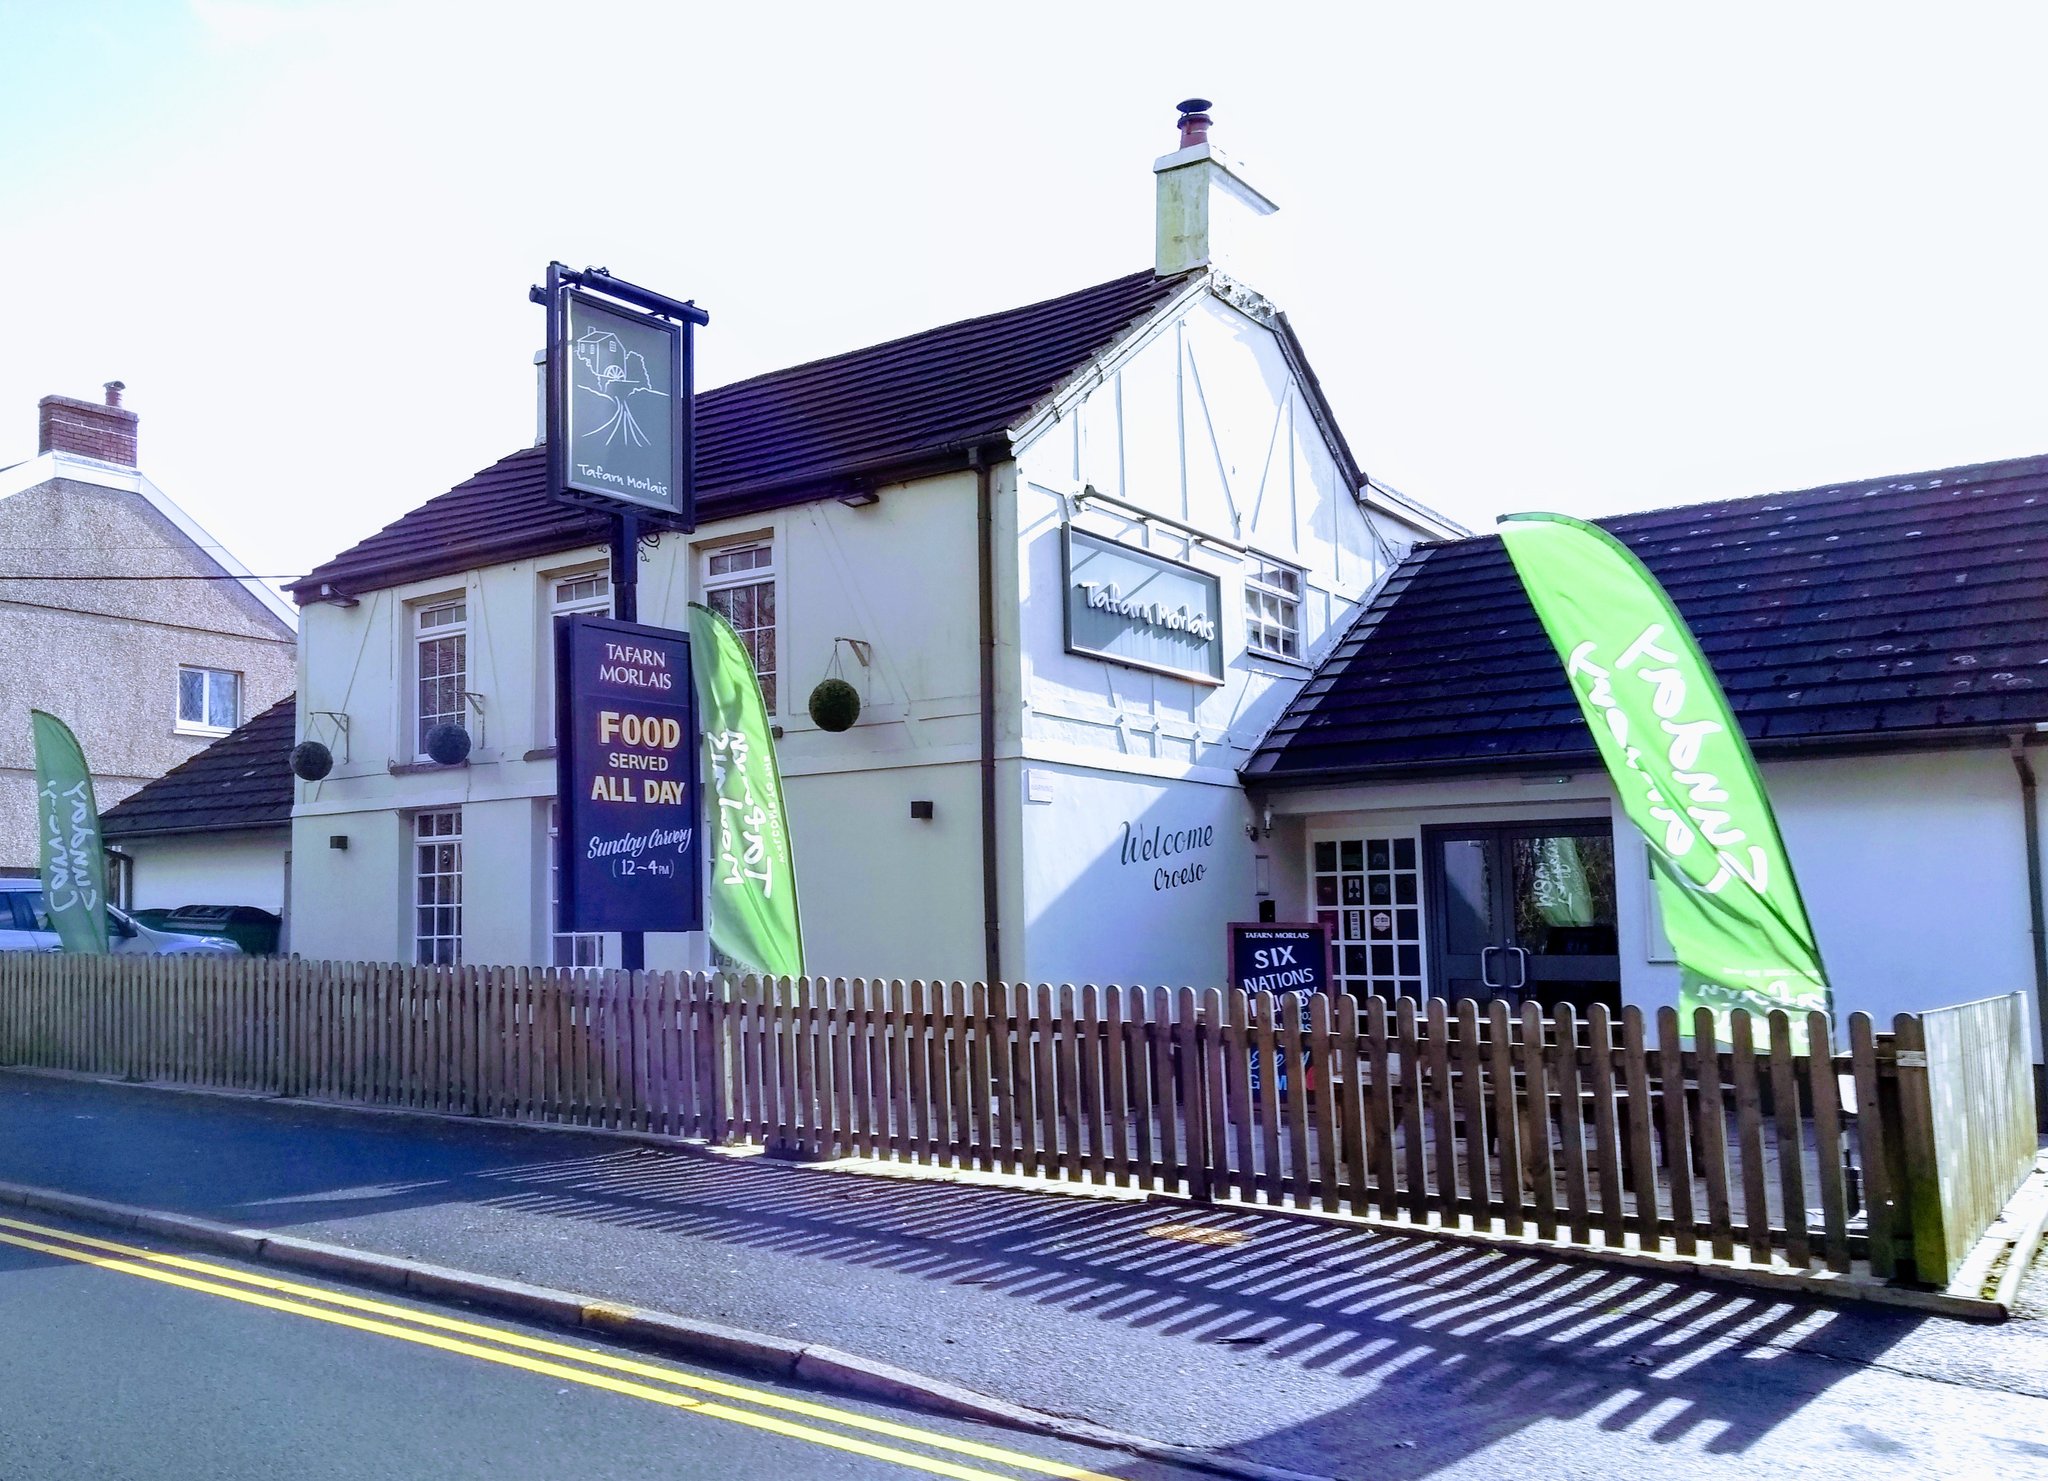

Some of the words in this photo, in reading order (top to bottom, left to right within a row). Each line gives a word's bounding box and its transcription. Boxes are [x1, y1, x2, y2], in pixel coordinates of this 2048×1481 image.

[577, 463, 624, 486] Tafarn
[626, 475, 668, 496] Morlais
[1078, 581, 1153, 625] Tafarn
[1155, 602, 1215, 641] Morlais
[605, 643, 666, 668] TAFARN
[599, 664, 672, 690] MORLAIS
[600, 710, 681, 749] FOOD
[608, 752, 669, 772] SERVED
[591, 775, 637, 803] ALL
[644, 779, 686, 805] DAY
[587, 832, 648, 859] Sunday
[648, 828, 693, 853] Carvery
[1119, 820, 1214, 866] Welcome
[1153, 862, 1208, 892] Croeso
[1244, 931, 1274, 940] TAFARN
[1274, 931, 1310, 940] MORLAIS
[1254, 945, 1298, 969] SIX
[1243, 967, 1315, 995] NATIONS
